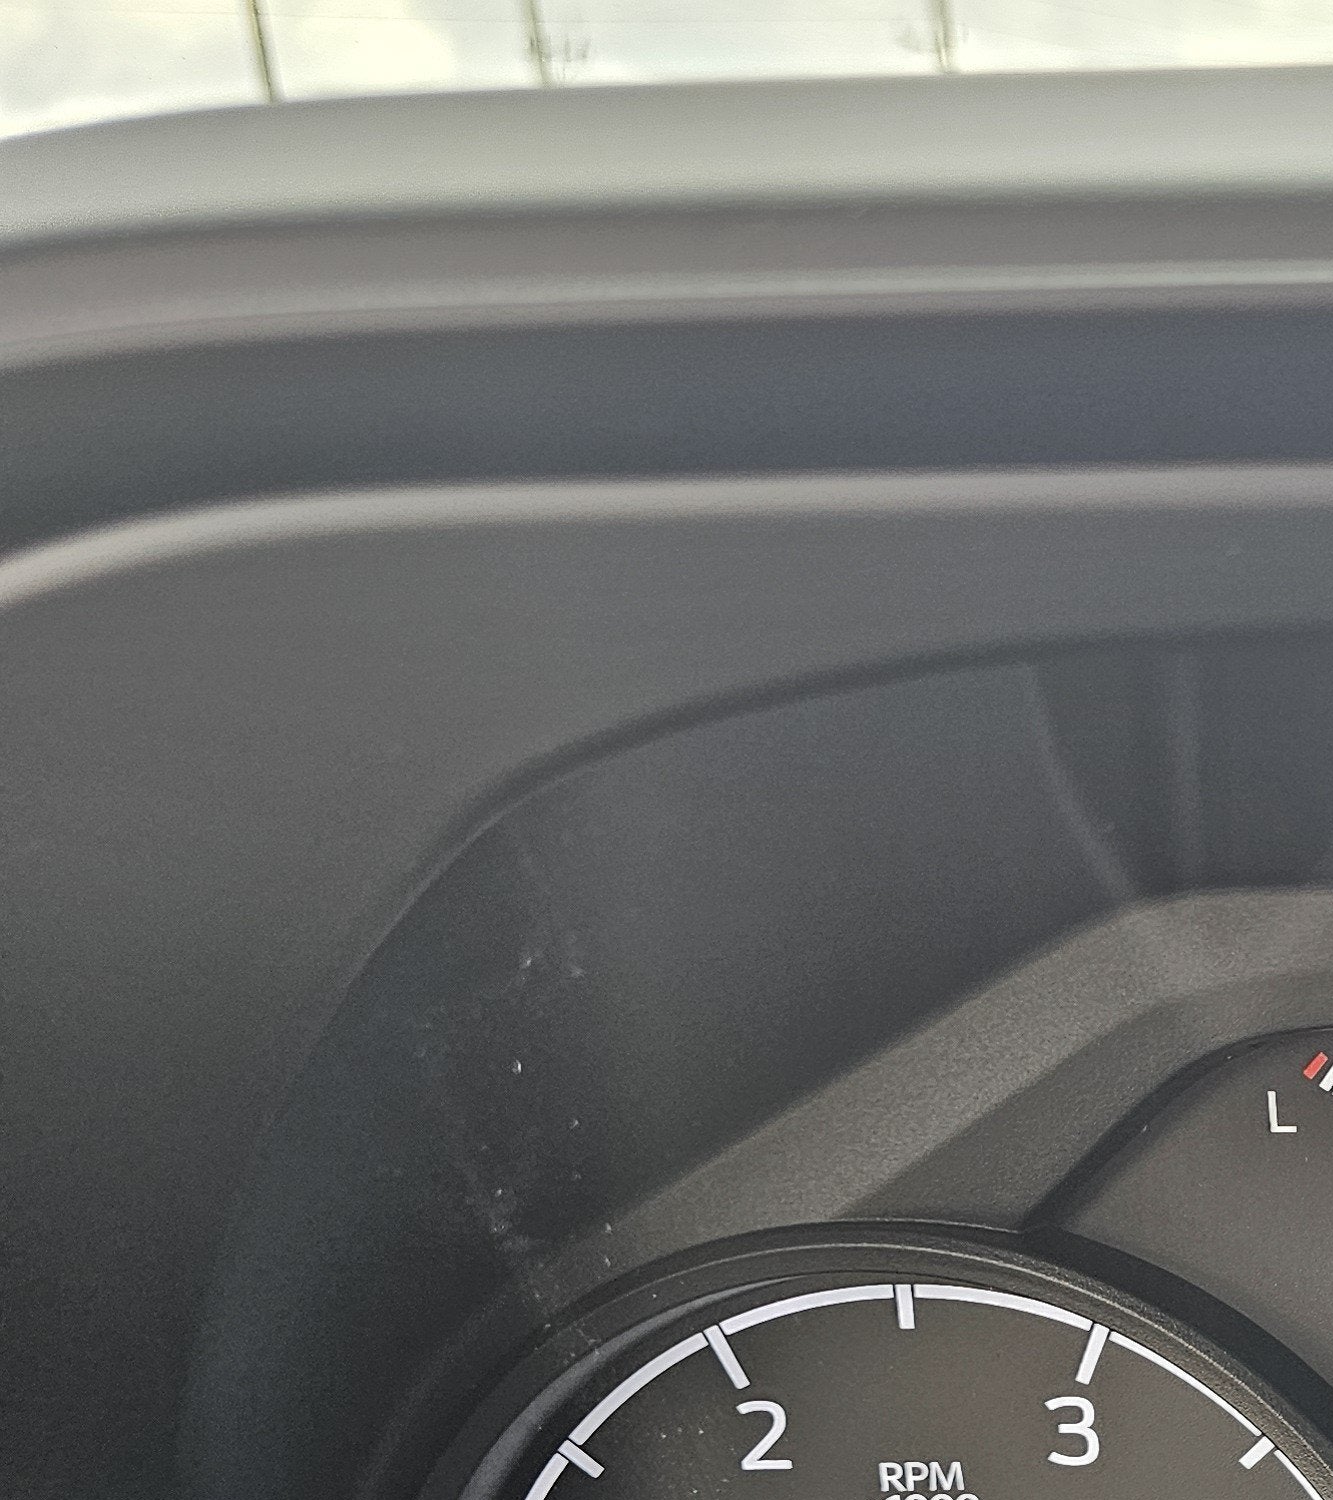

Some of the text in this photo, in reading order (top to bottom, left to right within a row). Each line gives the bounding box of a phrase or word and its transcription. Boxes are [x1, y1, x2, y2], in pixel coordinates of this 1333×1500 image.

[1267, 1090, 1298, 1133] L
[736, 1400, 794, 1471] 2
[1044, 1396, 1100, 1467] 3
[878, 1461, 965, 1493] RPM
